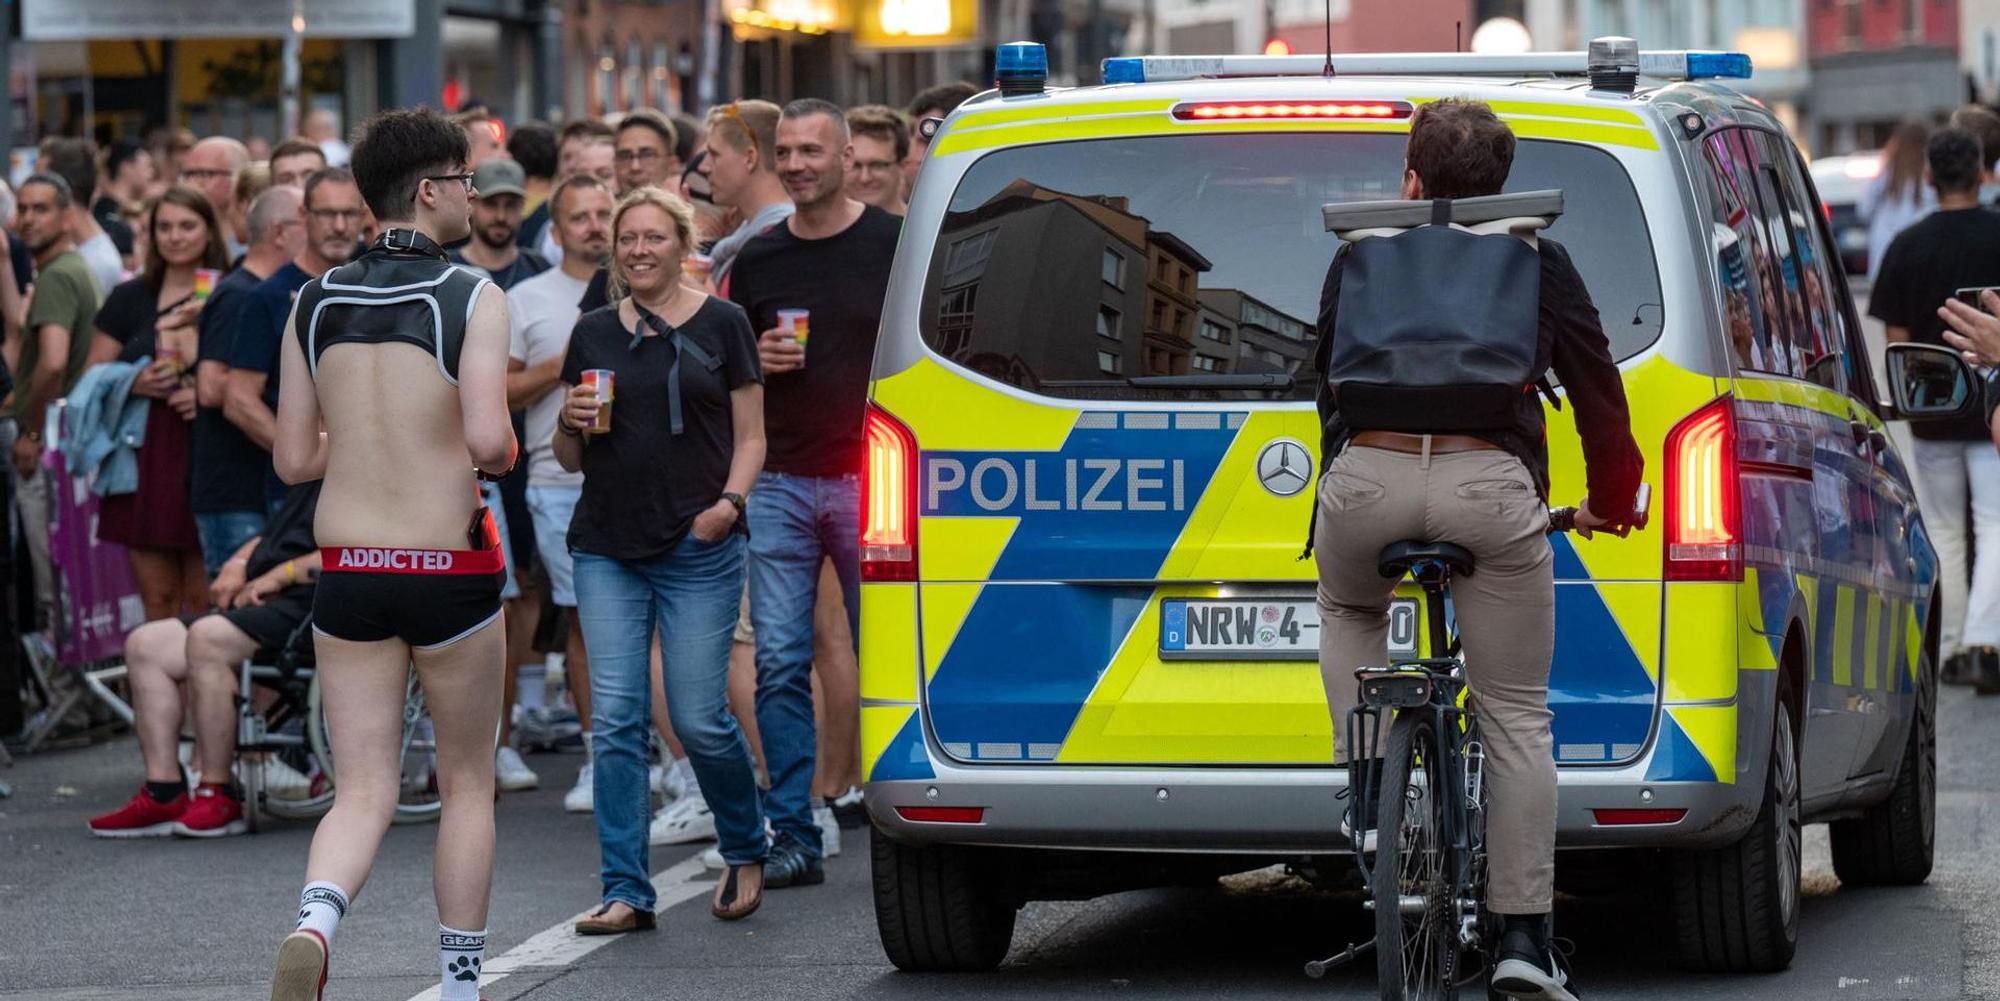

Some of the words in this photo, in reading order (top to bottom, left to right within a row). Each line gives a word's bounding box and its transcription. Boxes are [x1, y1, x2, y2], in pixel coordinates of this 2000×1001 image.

[927, 457, 1185, 511] POLIZEI
[338, 548, 453, 570] ADDICTED
[1169, 631, 1179, 642] D
[1186, 606, 1257, 645] NRW
[442, 935, 484, 945] GEAR
